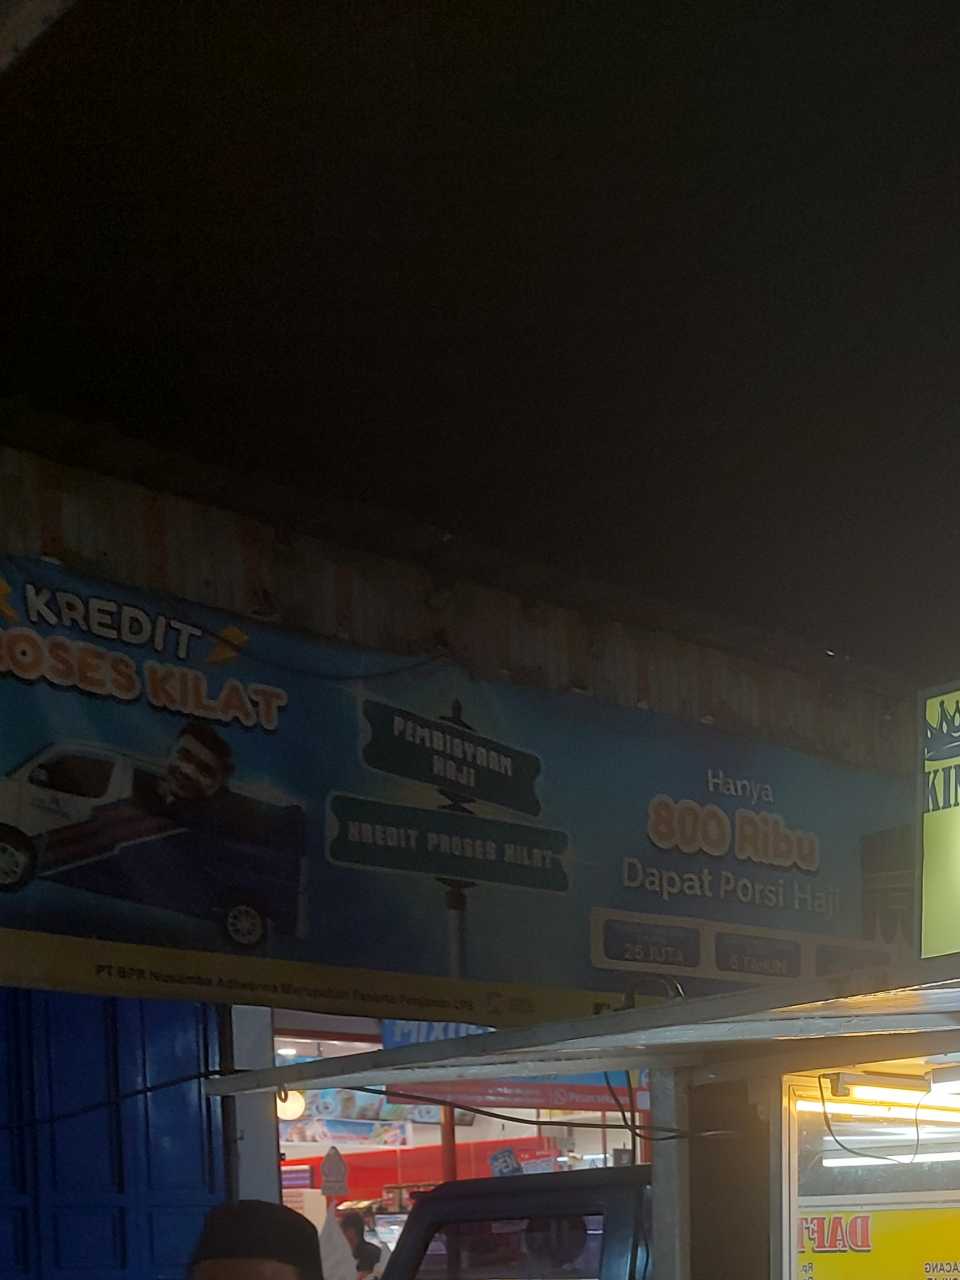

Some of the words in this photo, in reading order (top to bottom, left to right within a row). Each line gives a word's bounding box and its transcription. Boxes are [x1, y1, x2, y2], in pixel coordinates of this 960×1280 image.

[25, 583, 202, 659] KREDIT
[0, 626, 141, 700] OSES
[143, 660, 288, 731] KILAT
[707, 769, 775, 804] Hanya
[647, 794, 732, 858] 800
[733, 808, 819, 872] Ribu
[623, 856, 713, 901] Dapat
[720, 871, 785, 908] Porsi
[794, 878, 841, 920] Haji
